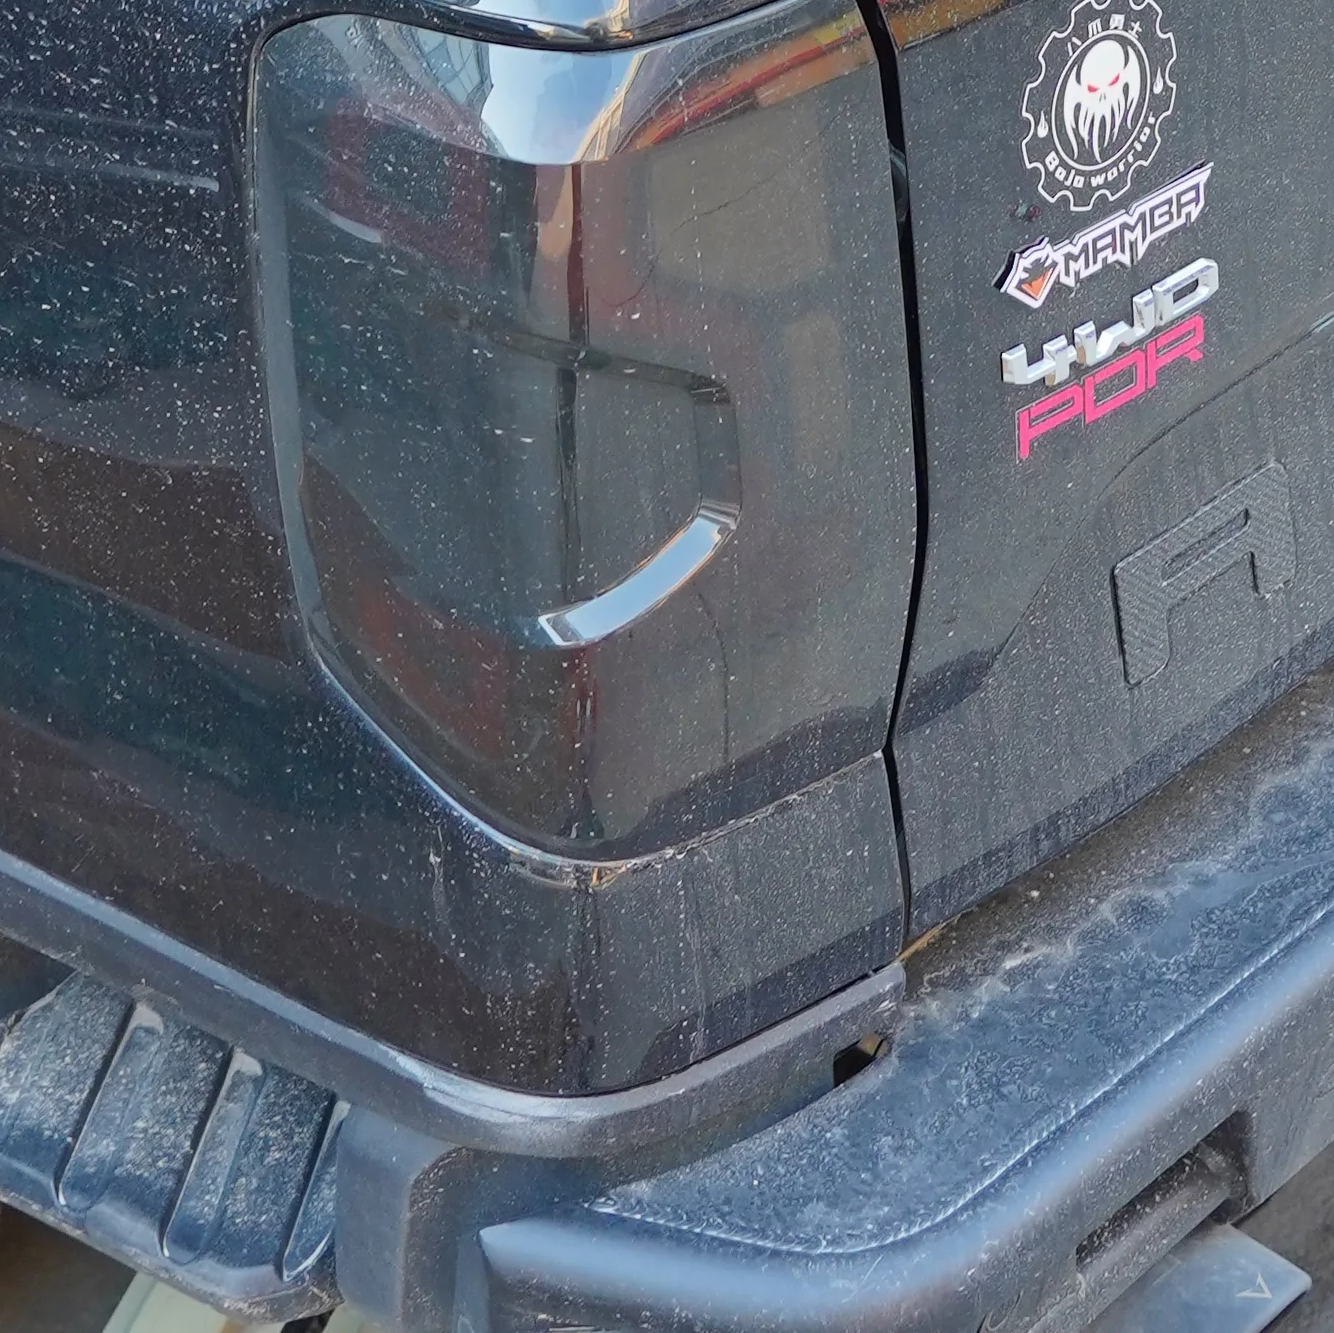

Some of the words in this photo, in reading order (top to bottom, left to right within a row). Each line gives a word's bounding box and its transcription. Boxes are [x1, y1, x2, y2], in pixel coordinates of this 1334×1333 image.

[1057, 168, 1212, 286] MAMBA
[1001, 257, 1219, 386] 4WD
[1016, 313, 1205, 461] PDR
